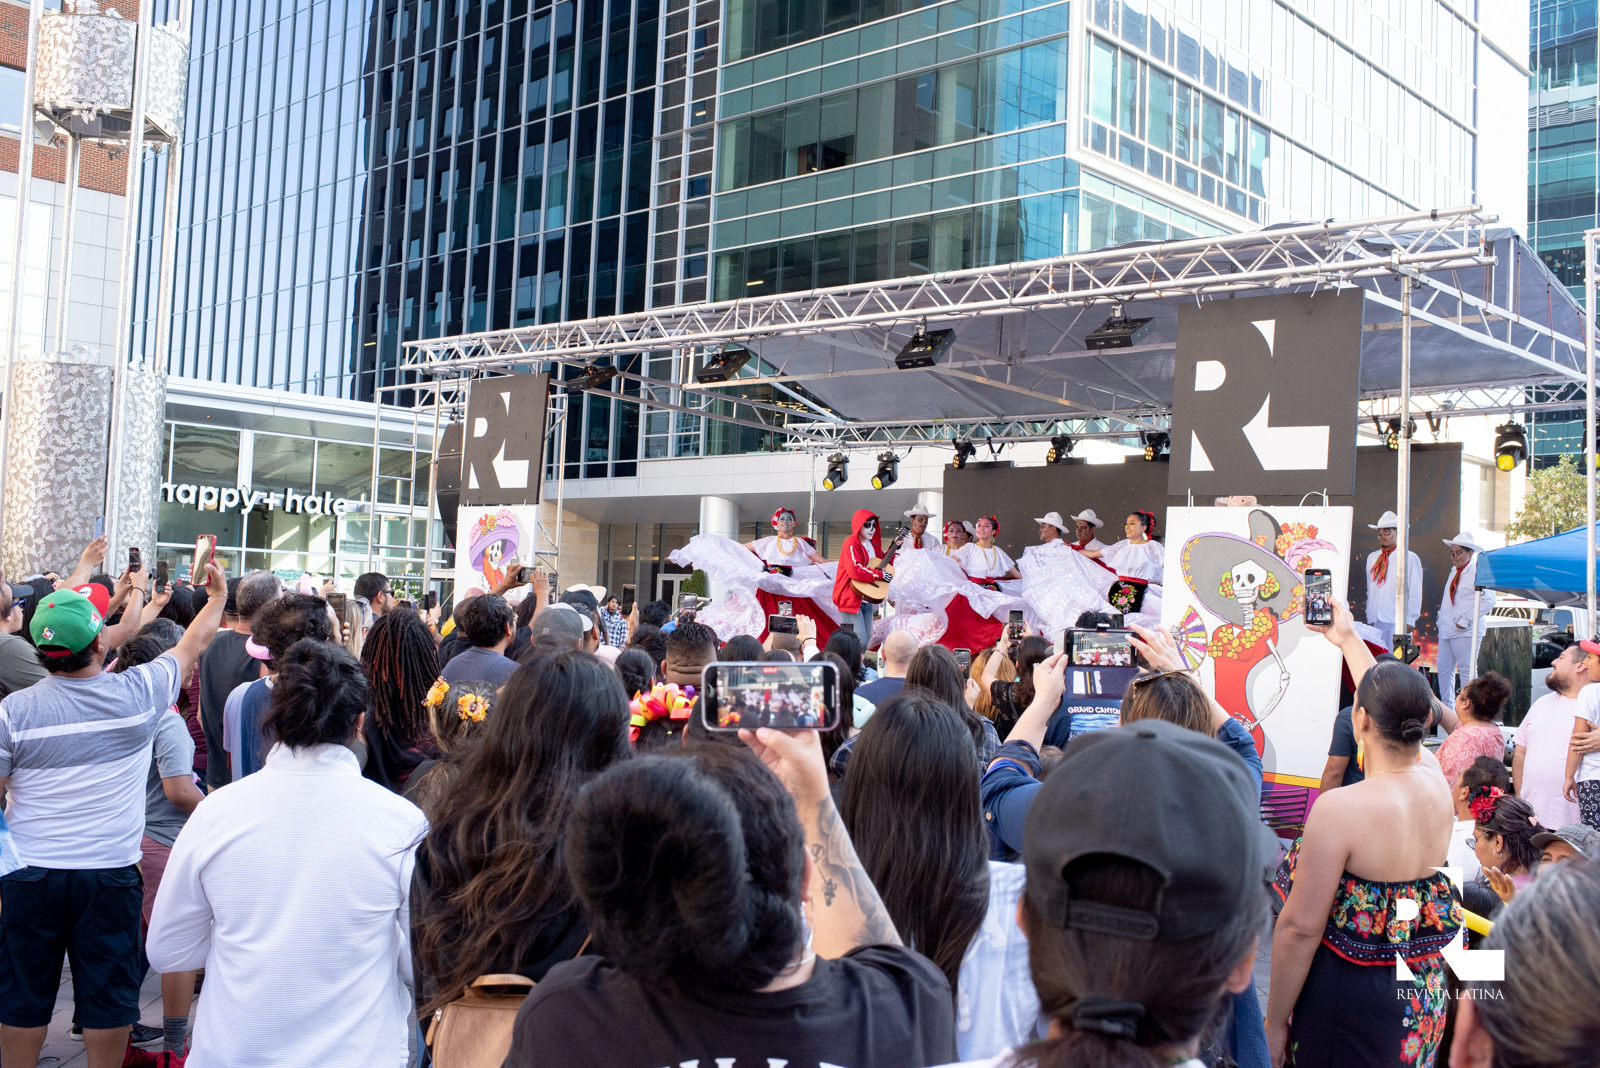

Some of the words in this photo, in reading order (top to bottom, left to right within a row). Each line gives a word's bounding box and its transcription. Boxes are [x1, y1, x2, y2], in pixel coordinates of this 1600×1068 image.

[1190, 319, 1330, 471] RL
[469, 391, 530, 489] RL
[160, 476, 259, 515] happy
[1067, 706, 1094, 714] GRAND
